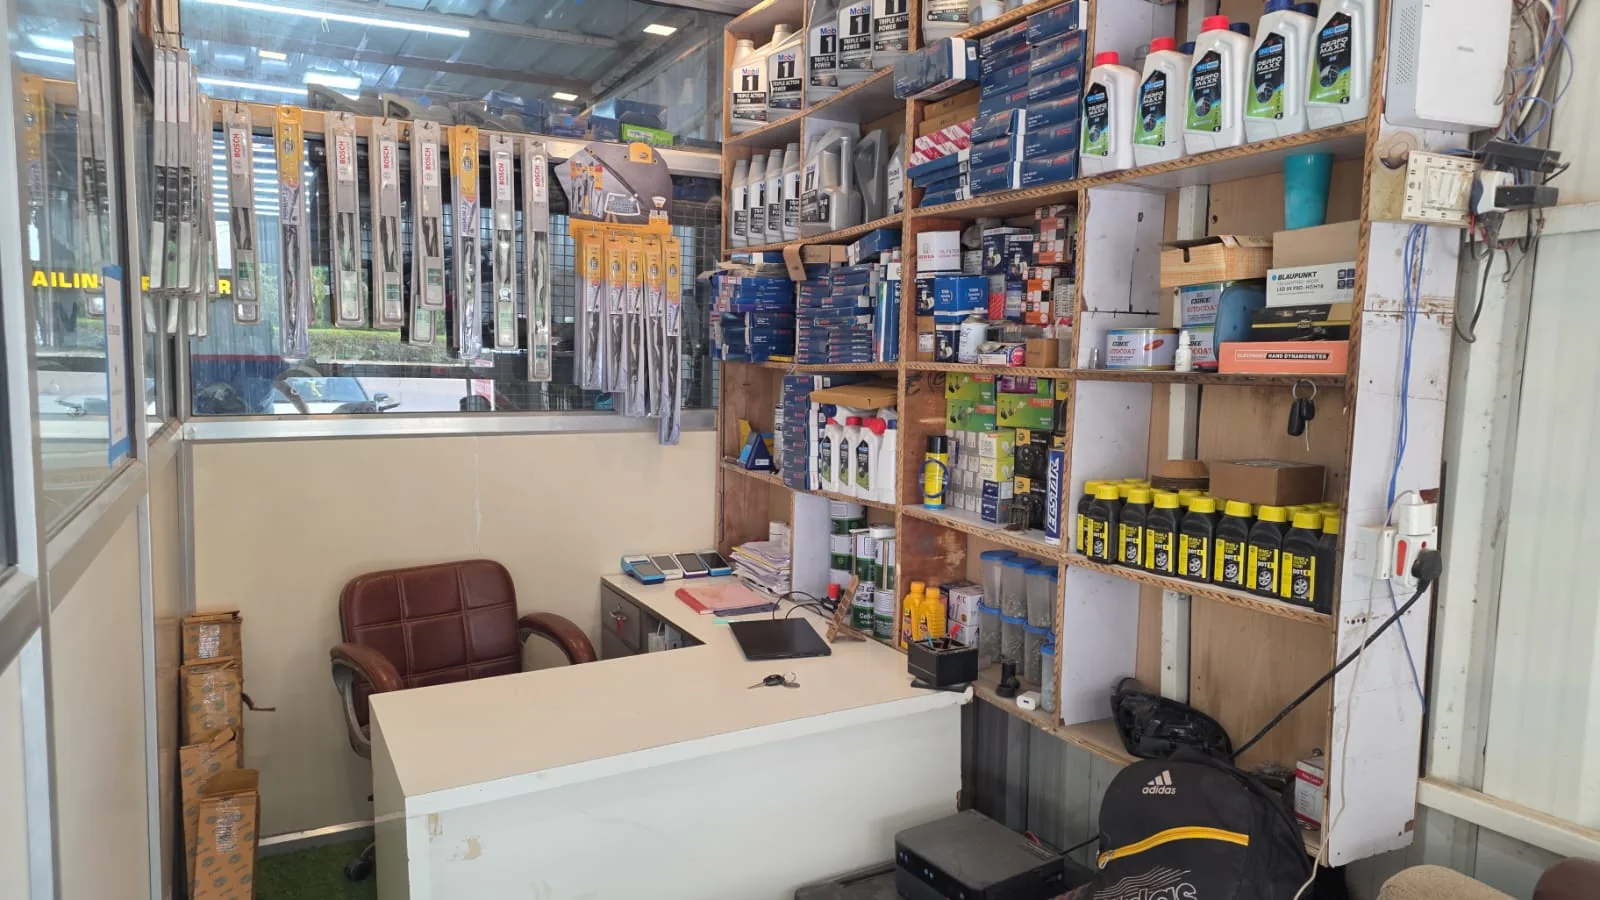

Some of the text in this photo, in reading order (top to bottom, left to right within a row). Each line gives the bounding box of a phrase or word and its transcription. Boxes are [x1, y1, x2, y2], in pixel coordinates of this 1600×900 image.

[849, 6, 871, 16] Mobil
[895, 14, 909, 22] ACT
[855, 16, 863, 33] 1
[826, 36, 833, 53] 1
[1320, 43, 1346, 54] MAXX
[777, 53, 796, 61] Mobil
[782, 61, 790, 78] 1
[1256, 62, 1280, 73] MAXX
[746, 76, 754, 91] 1
[232, 133, 241, 158] BOSCH
[338, 140, 347, 164] BOSCH
[383, 145, 391, 169] BOSCH
[498, 162, 506, 186] BOSCH
[534, 165, 542, 188] BOSCH
[31, 271, 103, 288] AILIN
[1277, 271, 1317, 281] BLAUPUNKT
[1047, 457, 1060, 533] ECSTAR
[1142, 785, 1176, 795] adidas
